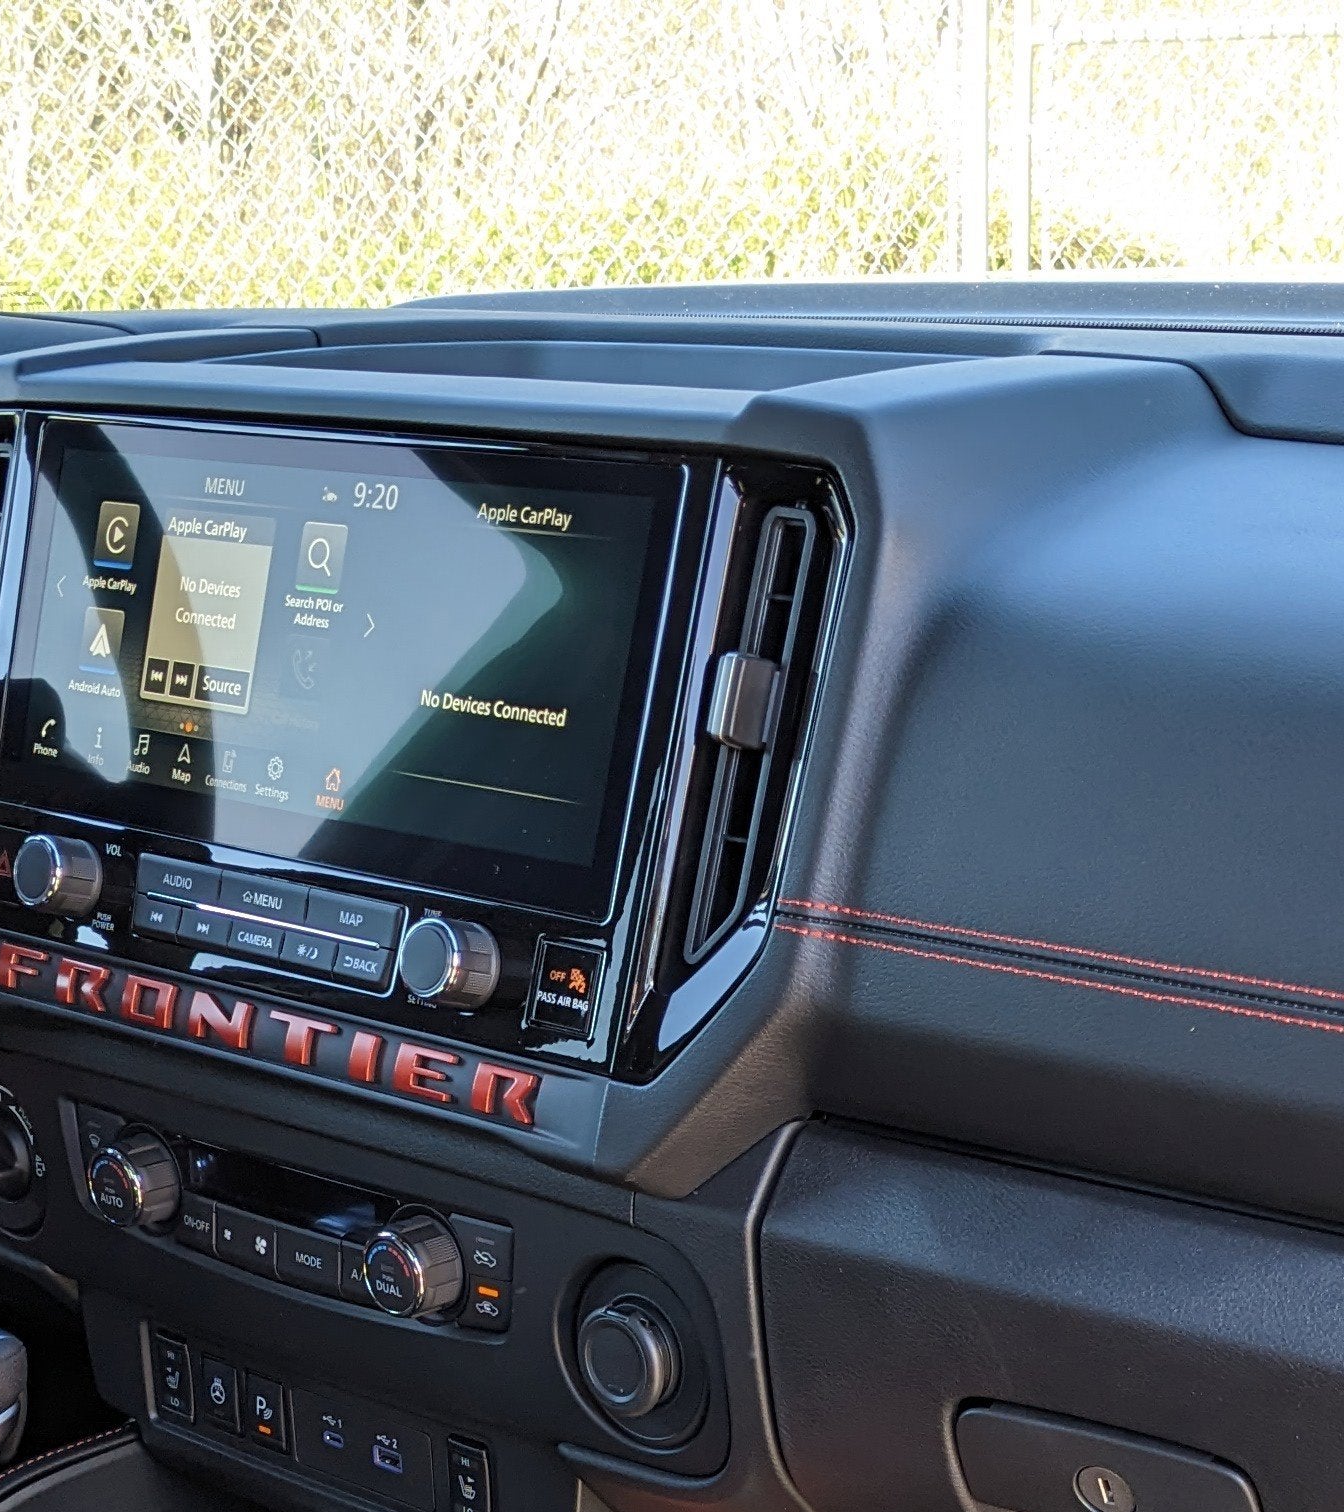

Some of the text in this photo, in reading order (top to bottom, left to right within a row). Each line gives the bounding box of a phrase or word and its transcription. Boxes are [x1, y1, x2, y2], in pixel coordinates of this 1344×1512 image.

[204, 477, 245, 496] MENU
[353, 482, 399, 510] 9:20
[477, 503, 572, 532] Apple CarPlay
[168, 517, 247, 542] Apple CarPlay
[82, 575, 137, 595] Apple CarPlay
[180, 576, 241, 598] No Devices
[285, 595, 314, 611] Search
[332, 602, 343, 613] or
[175, 607, 236, 630] Connected
[294, 613, 329, 629] Address
[68, 679, 121, 698] Android Auto
[203, 676, 241, 695] Source
[421, 689, 567, 727] No Devices Connected
[33, 742, 58, 757] Phone
[87, 754, 104, 766] Info
[127, 761, 150, 775] Audio
[172, 768, 191, 784] Map
[205, 774, 247, 793] Connections
[254, 784, 289, 802] Settings
[316, 794, 345, 811] MENU
[106, 843, 122, 857] VOL
[163, 873, 192, 890] AUDIO
[253, 892, 283, 910] MENU
[339, 910, 363, 927] MAP
[238, 931, 273, 949] CAMERA
[353, 958, 377, 973] BACK
[549, 969, 566, 982] OFF
[536, 990, 589, 1014] PASS AIR BAG
[100, 1193, 124, 1209] AUTO
[184, 1214, 210, 1232] ON-OFF
[295, 1251, 322, 1270] MODE
[351, 1268, 363, 1281] A/
[376, 1279, 403, 1298] DUAL
